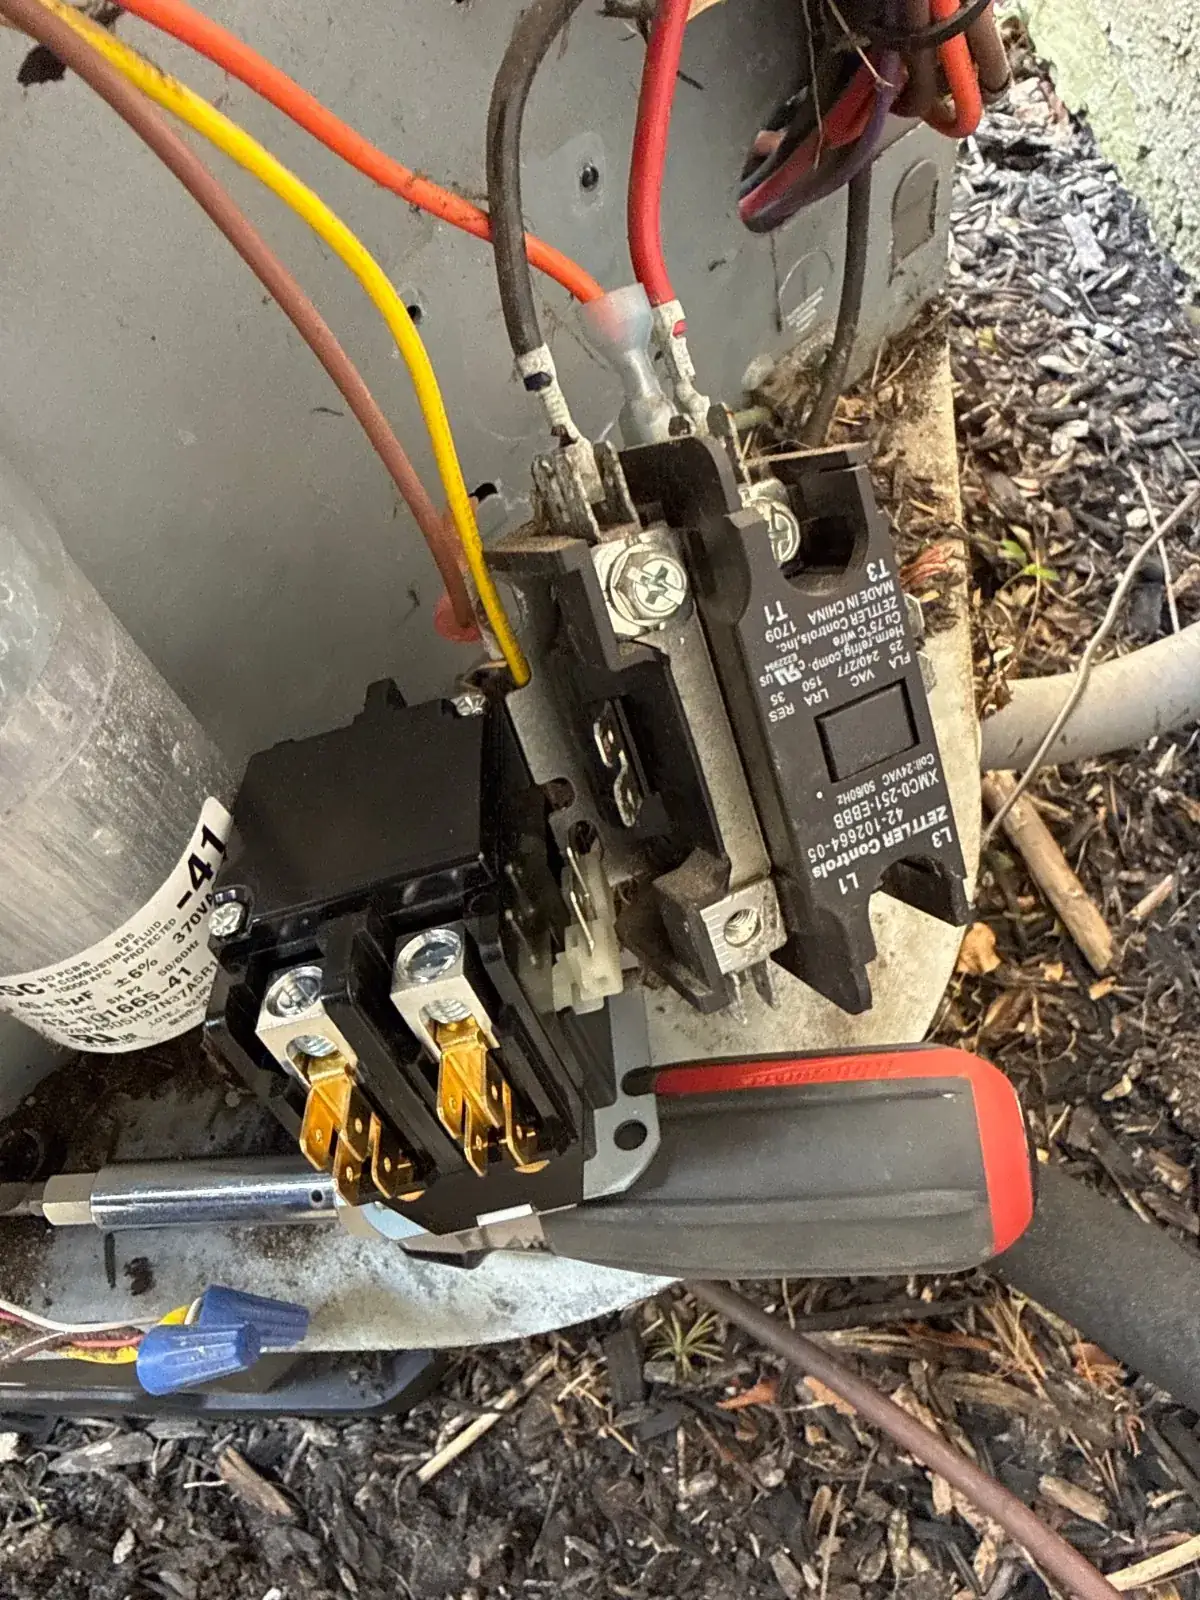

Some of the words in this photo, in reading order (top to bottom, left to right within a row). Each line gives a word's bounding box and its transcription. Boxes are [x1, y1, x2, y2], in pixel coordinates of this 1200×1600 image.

[866, 558, 891, 582] T3
[846, 594, 860, 607] IN
[860, 579, 895, 600] MADE
[764, 600, 788, 625] T1
[807, 600, 845, 625] CHINA
[850, 595, 899, 626] ZETTLER
[885, 610, 901, 625] Cu
[765, 620, 797, 643] 1709
[832, 629, 857, 646] wire
[889, 640, 904, 654] 25
[837, 650, 881, 678] 240/277
[888, 651, 912, 669] FLA
[801, 675, 823, 692] 150
[850, 668, 876, 687] VAC
[770, 691, 786, 706] 35
[803, 687, 829, 706] LRA
[768, 702, 796, 723] RES
[836, 780, 876, 805] 50/60Hz
[807, 807, 903, 864] 42-102664-05
[881, 805, 949, 848] ZETTLER
[931, 826, 953, 848] L3
[811, 838, 881, 879] Controls
[838, 871, 859, 895] L1
[57, 945, 133, 985] COMBUSTIBLE
[133, 920, 162, 946] FLUID
[122, 918, 177, 964] PROTECTED
